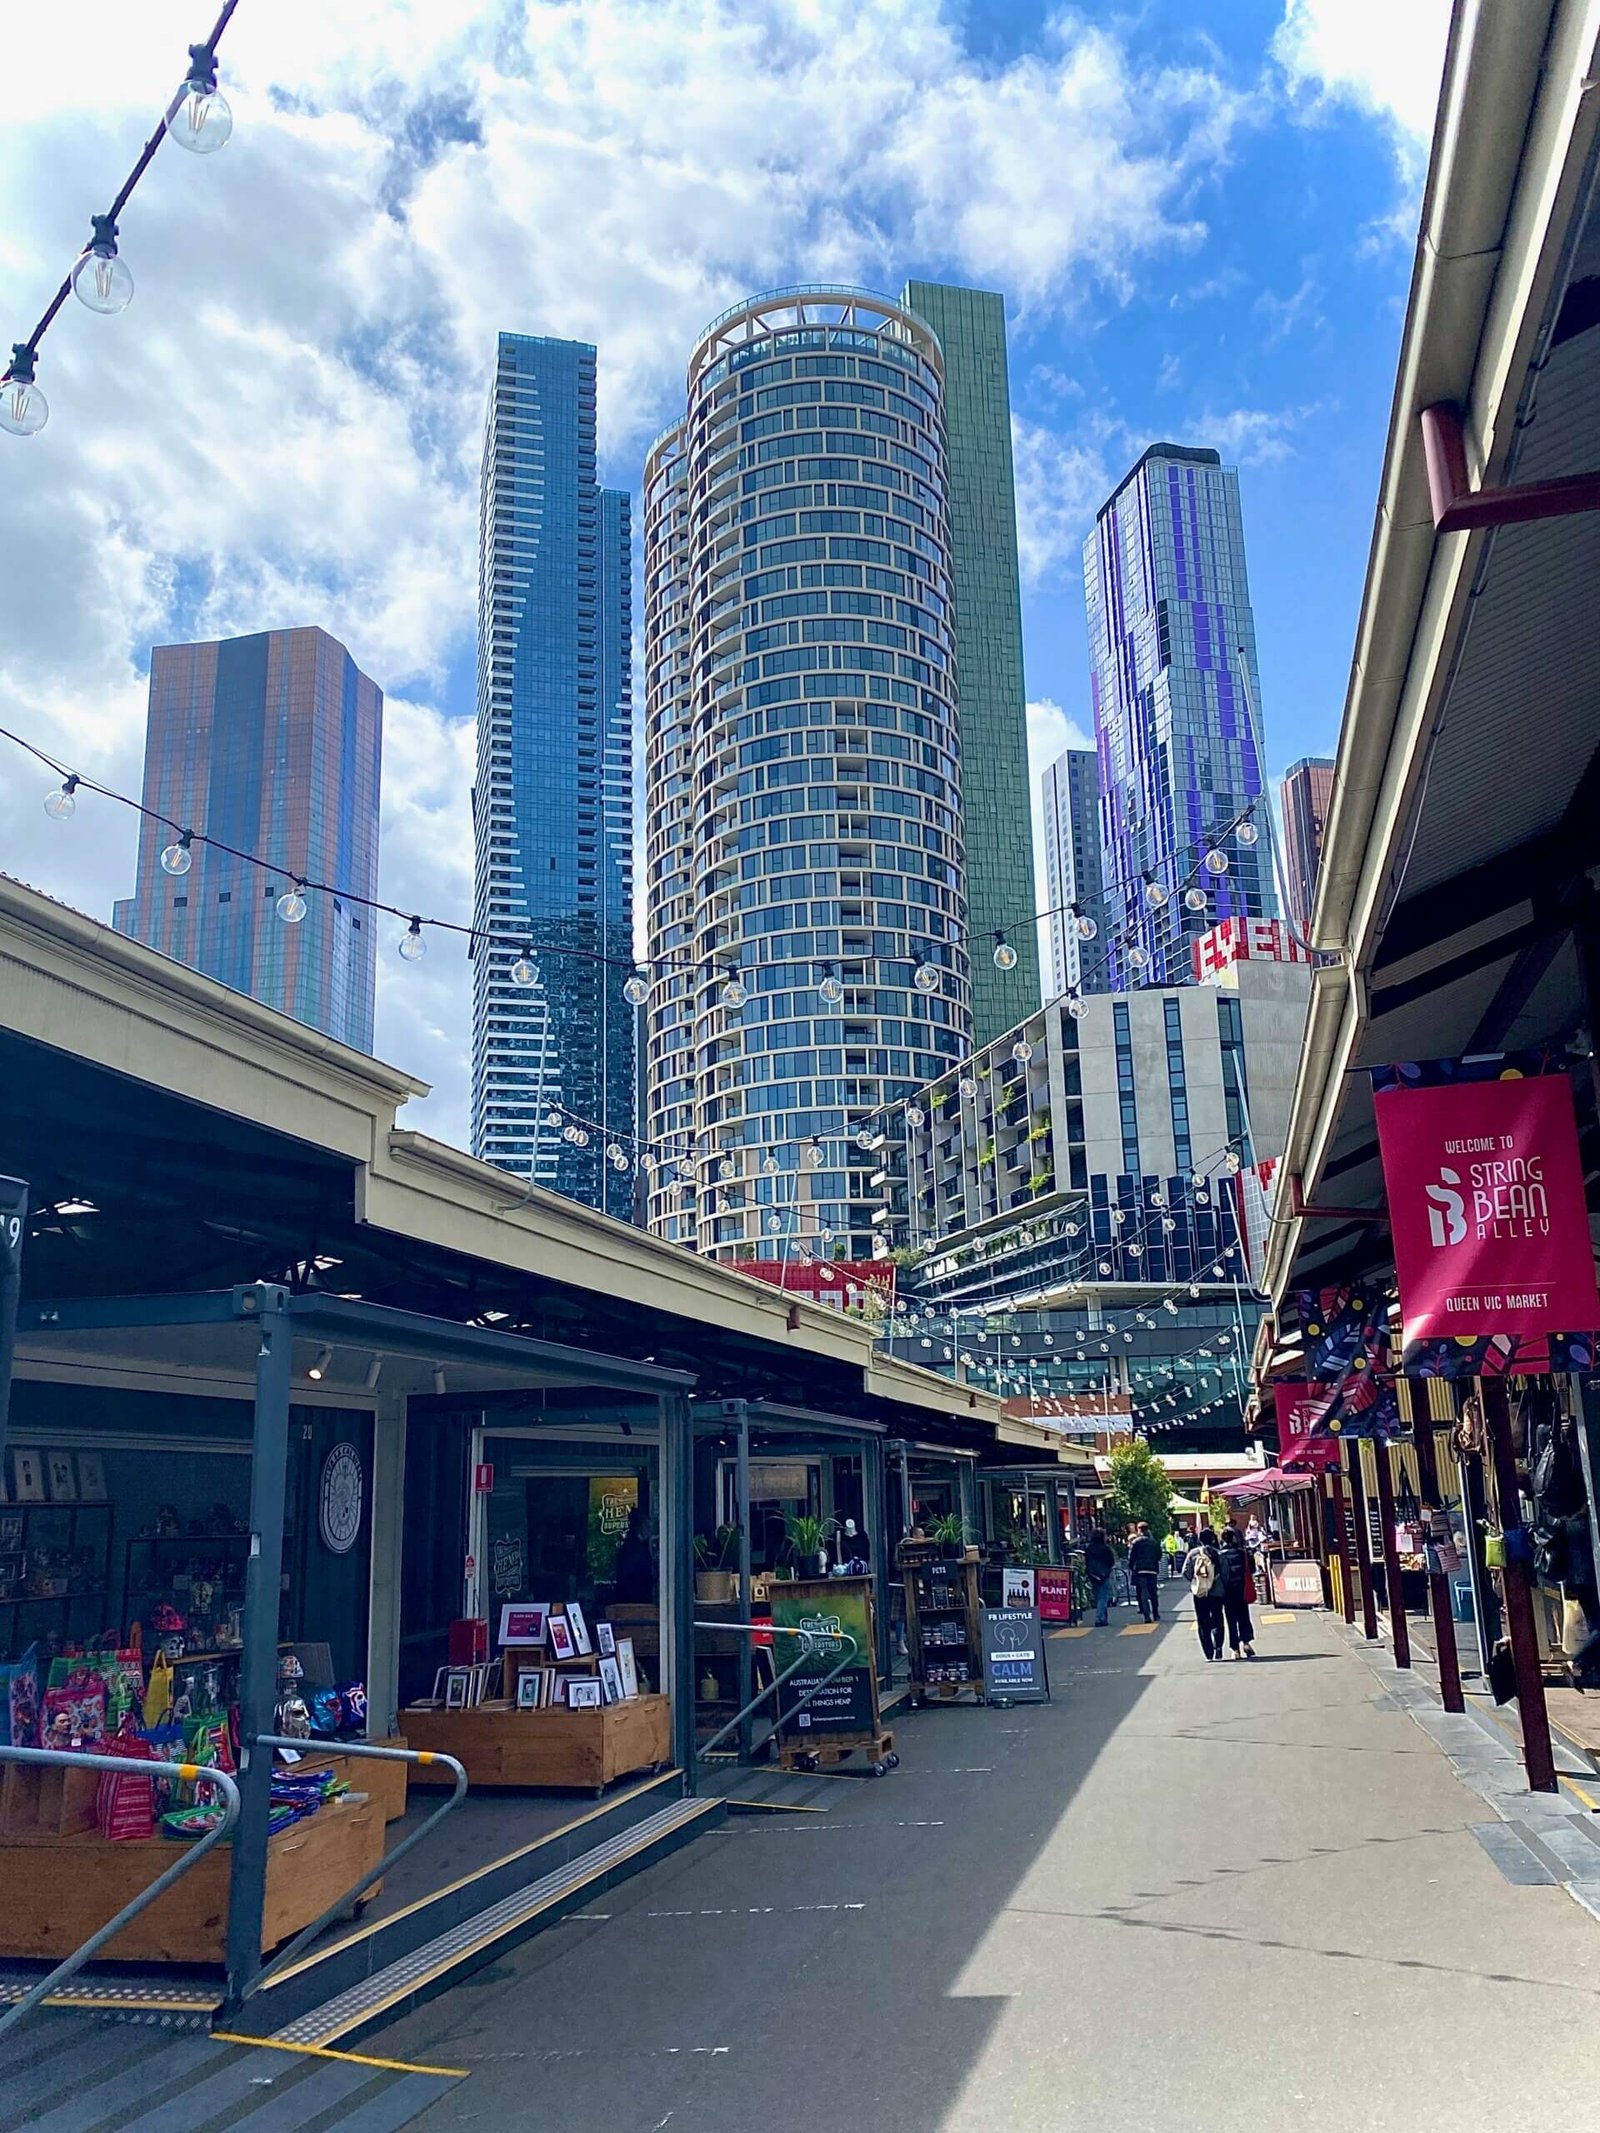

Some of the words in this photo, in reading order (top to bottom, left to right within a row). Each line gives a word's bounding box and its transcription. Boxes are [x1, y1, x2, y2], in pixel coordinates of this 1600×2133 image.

[1445, 1138, 1495, 1154] WELCOME
[1500, 1135, 1514, 1149] TO
[1470, 1156, 1543, 1188] STRING
[1473, 1183, 1548, 1223] BEAN
[1477, 1218, 1550, 1241] ALLEY
[1446, 1296, 1480, 1312] QUEEN
[1484, 1295, 1502, 1310] VIC
[1506, 1293, 1548, 1309] MARKET
[302, 1424, 313, 1440] 20
[1040, 1586, 1068, 1595] PLANT
[1041, 1578, 1067, 1587] SALE
[999, 1612, 1033, 1620] LIFESTYLE
[991, 1662, 1033, 1676] CALM
[834, 1698, 852, 1706] HEMP
